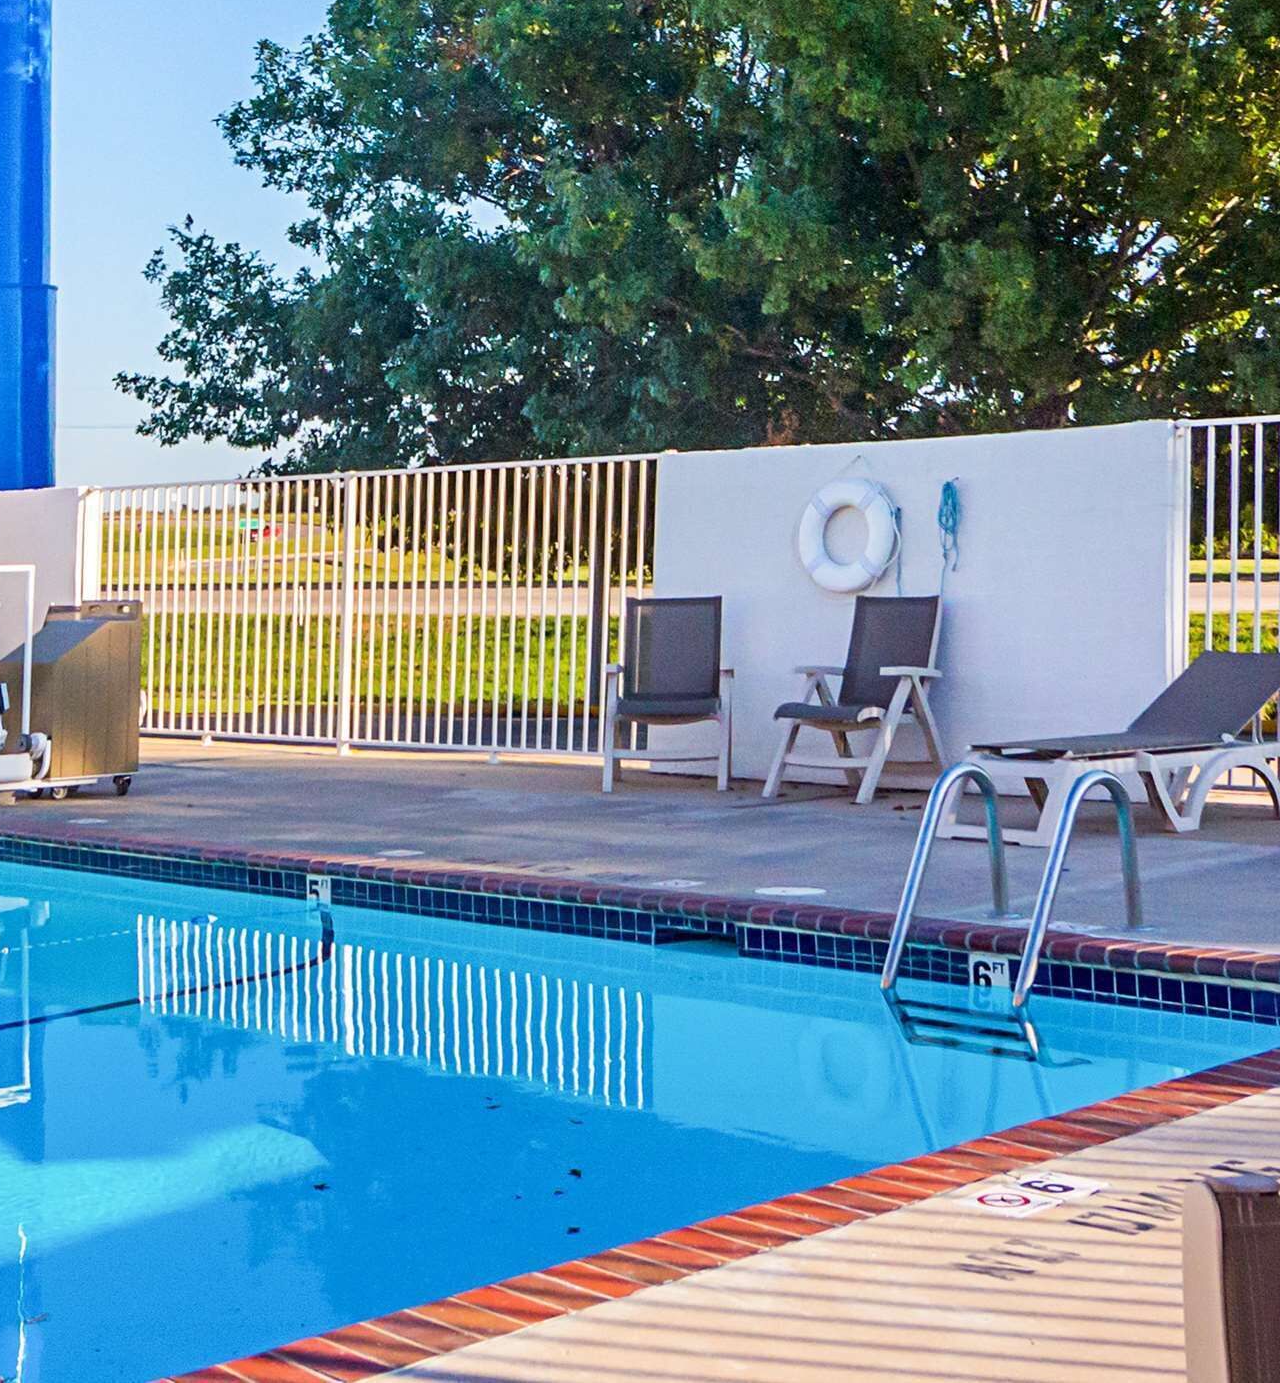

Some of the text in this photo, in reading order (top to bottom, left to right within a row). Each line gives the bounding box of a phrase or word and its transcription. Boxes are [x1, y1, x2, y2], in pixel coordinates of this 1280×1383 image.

[309, 879, 320, 901] 5
[973, 960, 1005, 988] 6 FT
[1020, 1180, 1075, 1193] 6
